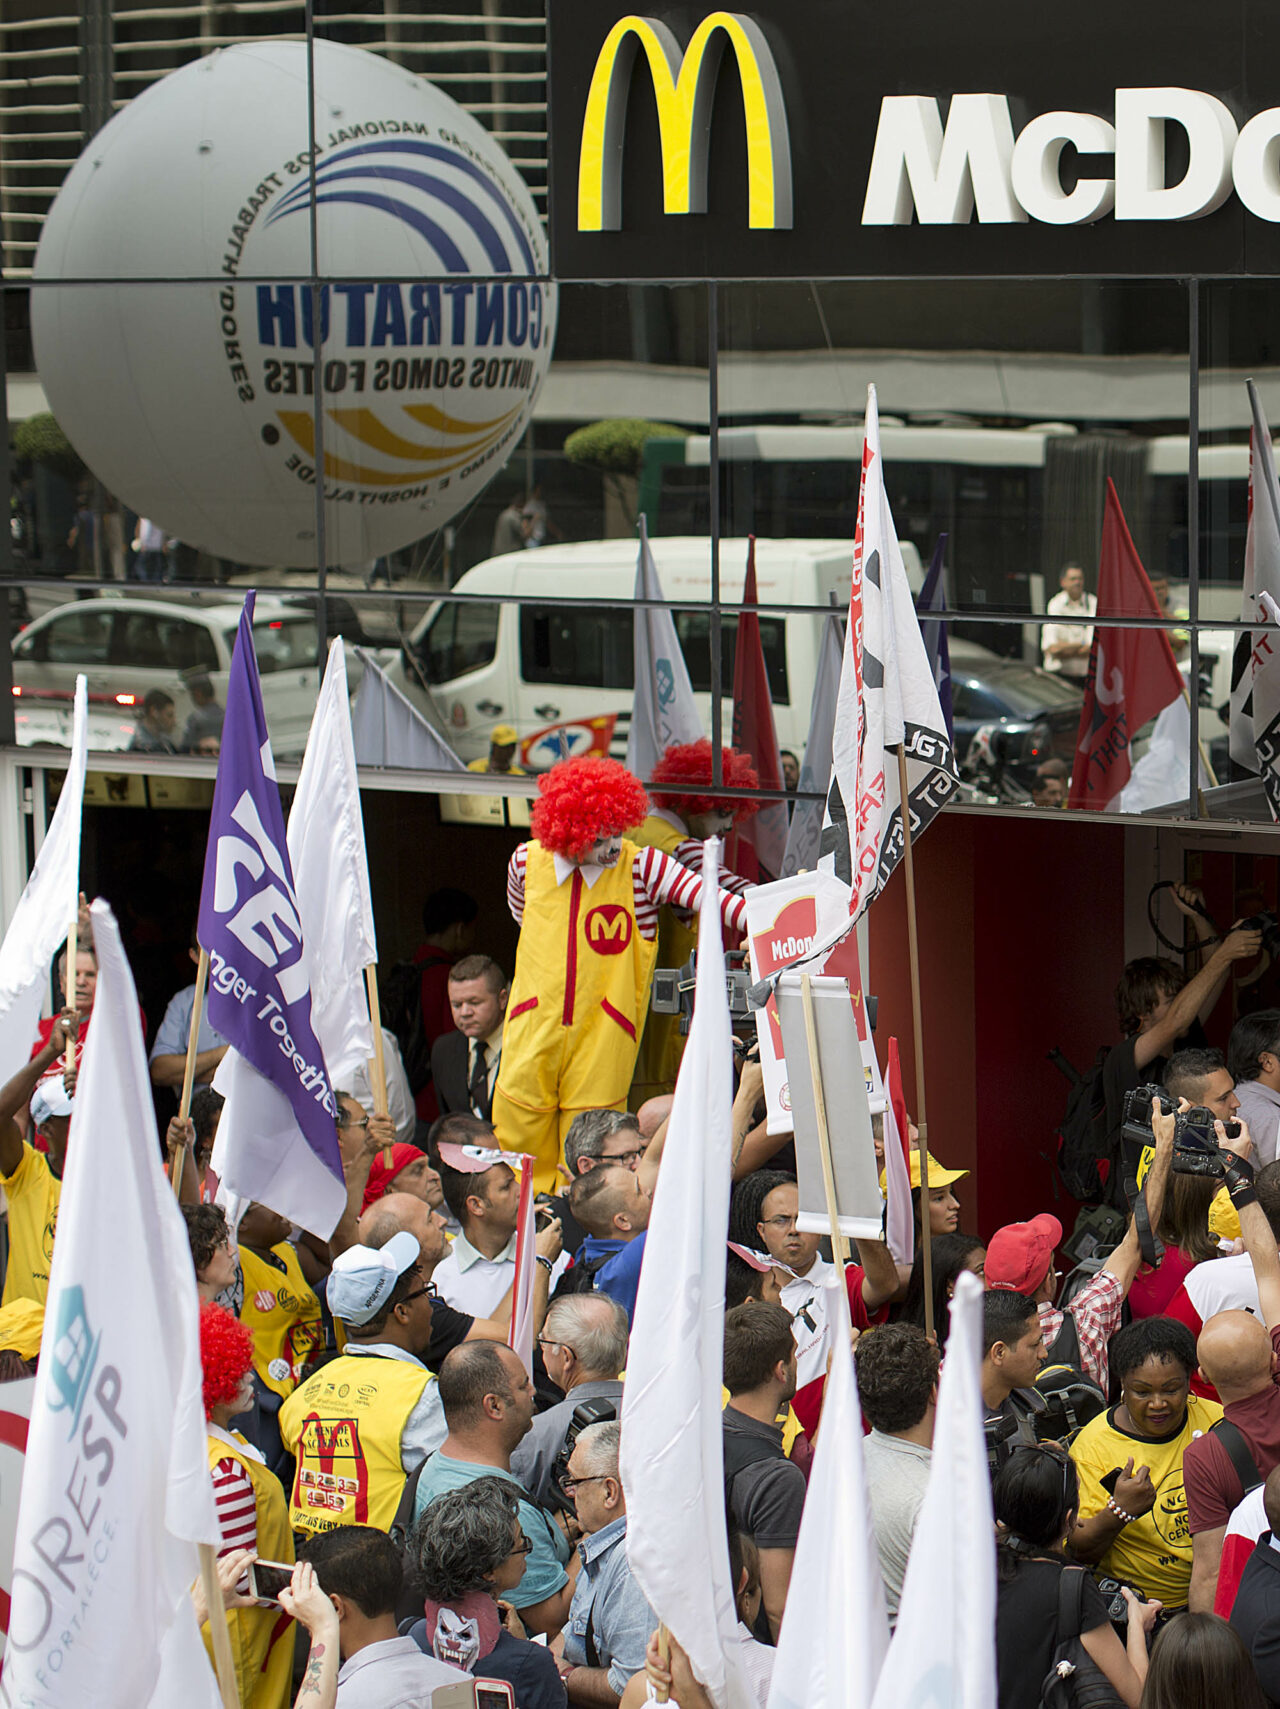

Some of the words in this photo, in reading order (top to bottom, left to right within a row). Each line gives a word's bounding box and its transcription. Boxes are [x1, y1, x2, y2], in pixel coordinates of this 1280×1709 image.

[209, 949, 258, 1004] nger
[256, 994, 343, 1119] Togethe
[364, 1278, 386, 1309] ARGENTINA
[1168, 1527, 1191, 1542] CEN
